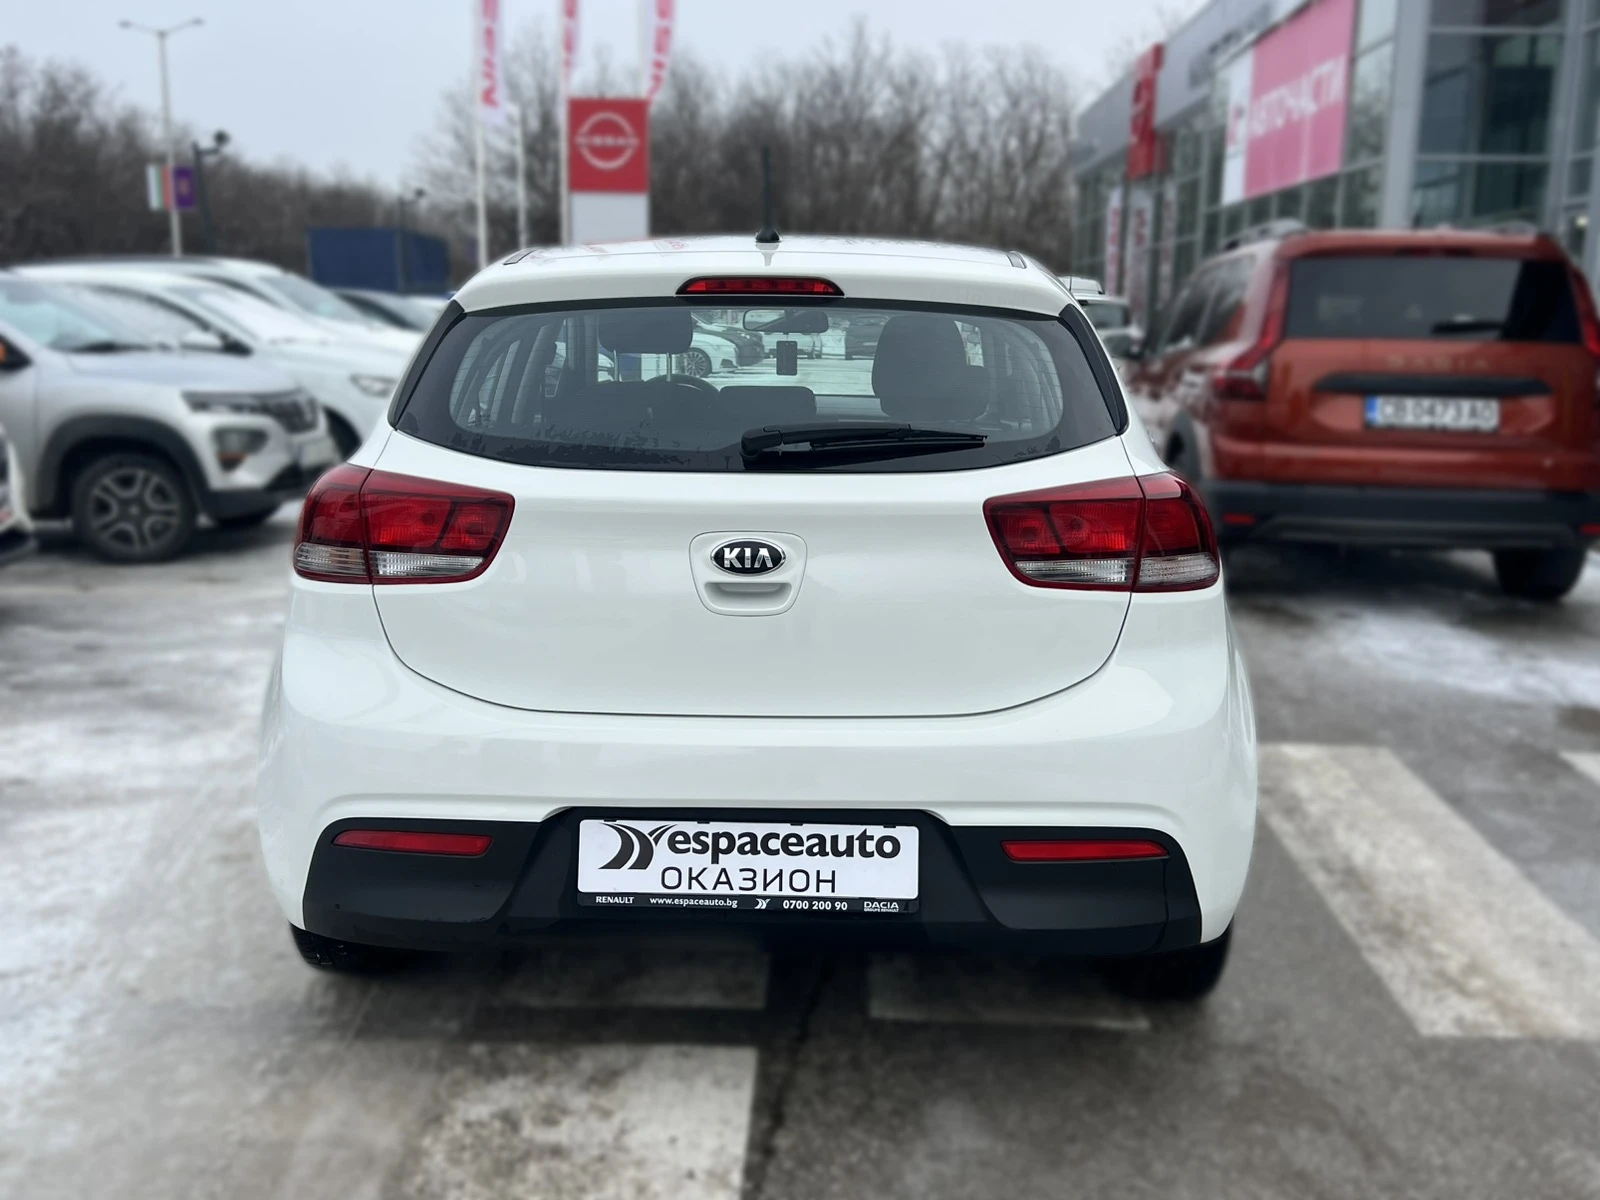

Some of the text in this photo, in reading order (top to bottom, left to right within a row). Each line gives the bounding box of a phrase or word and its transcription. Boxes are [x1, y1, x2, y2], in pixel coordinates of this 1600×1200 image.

[723, 547, 774, 568] KIA
[667, 828, 901, 865] espaceauto
[661, 866, 836, 893] ОКАЗИОН
[595, 896, 899, 911] RENAULT www.espaceauto.bg 0700 200 90 DACIA
